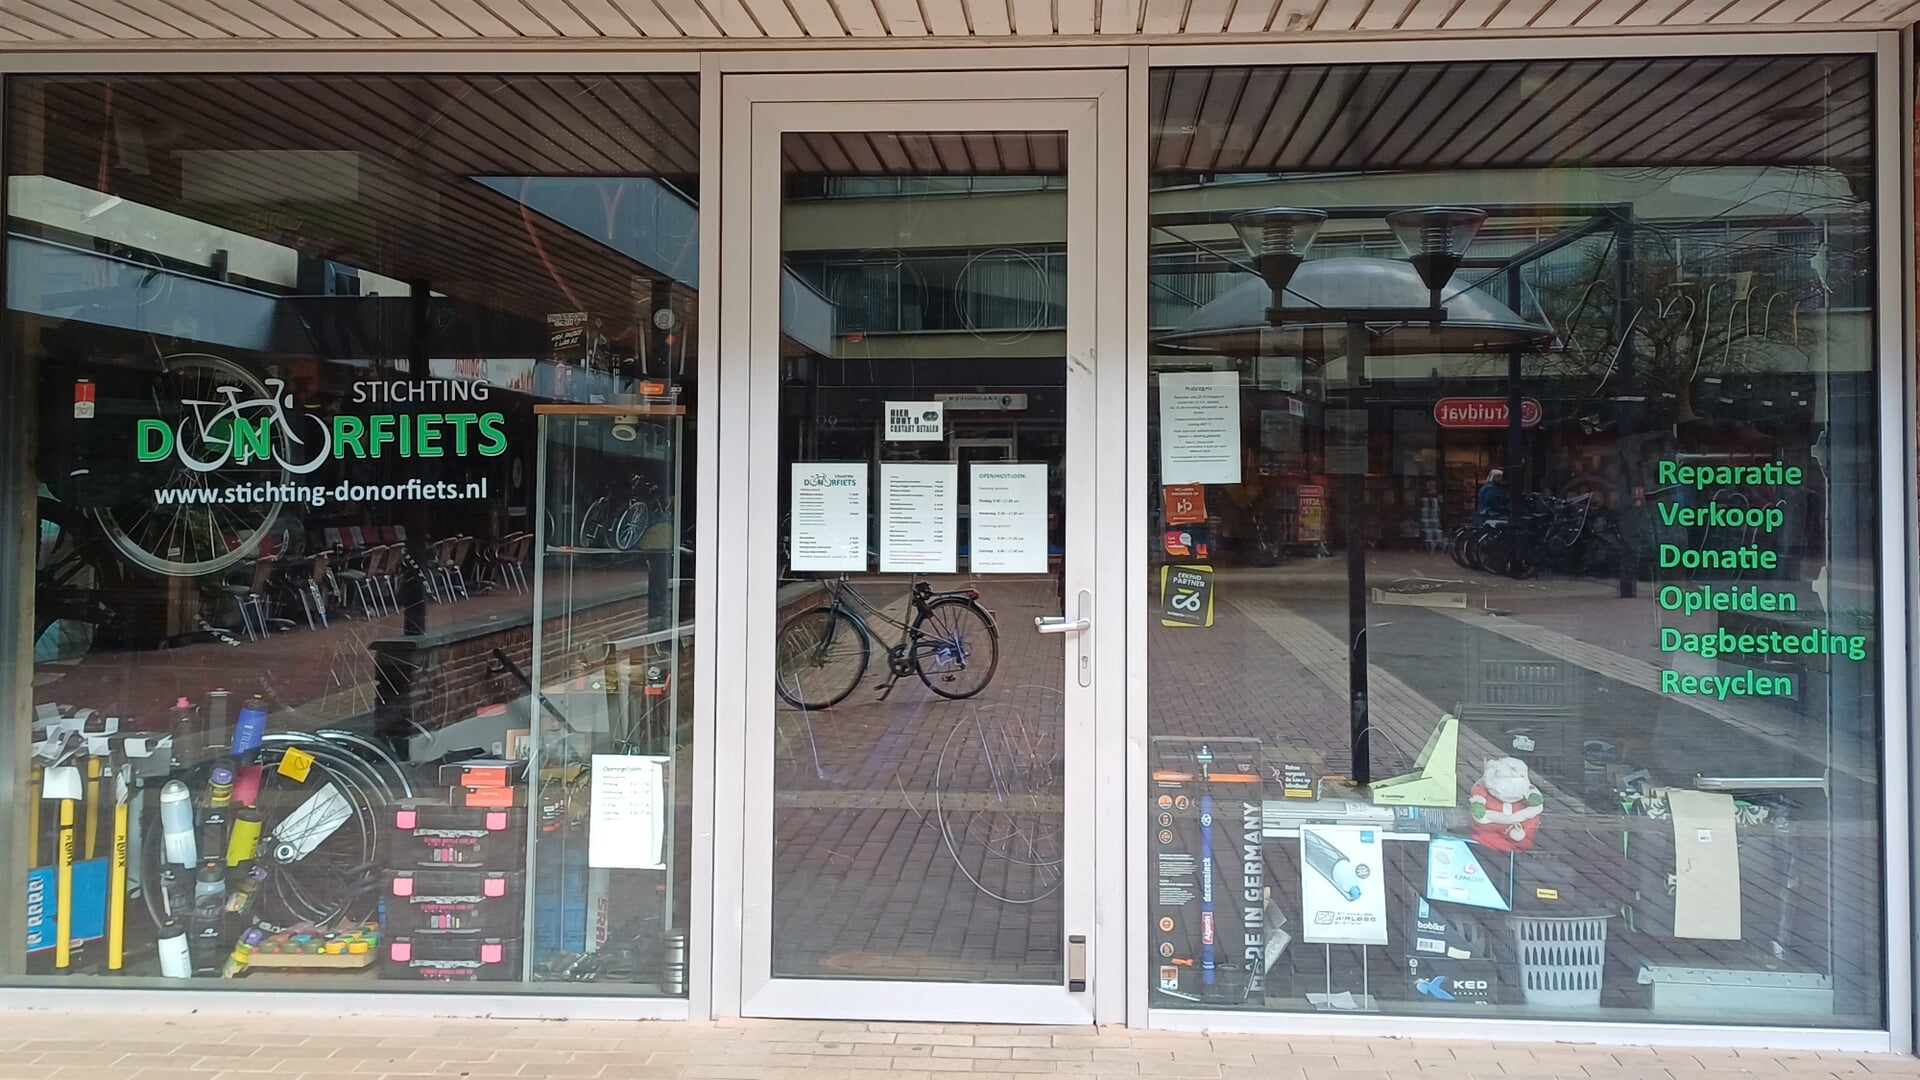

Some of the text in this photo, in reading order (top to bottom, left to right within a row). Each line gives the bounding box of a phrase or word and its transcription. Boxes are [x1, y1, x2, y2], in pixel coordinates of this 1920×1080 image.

[352, 379, 489, 404] STICHTING
[890, 408, 909, 417] HIER
[890, 416, 920, 425] KUNT U
[890, 424, 939, 432] CONTANT BETALEN
[136, 411, 508, 474] DONORFIETS
[1658, 460, 1802, 489] Reparatie
[154, 477, 488, 507] www.stichting-donorfiets.nl
[1658, 501, 1784, 532] Verkoop
[1659, 543, 1777, 569] Donatie
[1172, 576, 1206, 588] PARTNER
[1177, 572, 1202, 581] ERKEND
[1659, 584, 1796, 616] Opleiden
[1660, 627, 1867, 660] Dagbesteding
[1661, 669, 1793, 701] Recyclen
[1201, 857, 1212, 903] deceuninck
[1243, 802, 1264, 992] MADE IN GERMANY
[1417, 920, 1446, 931] bobike
[1453, 980, 1488, 990] KED
